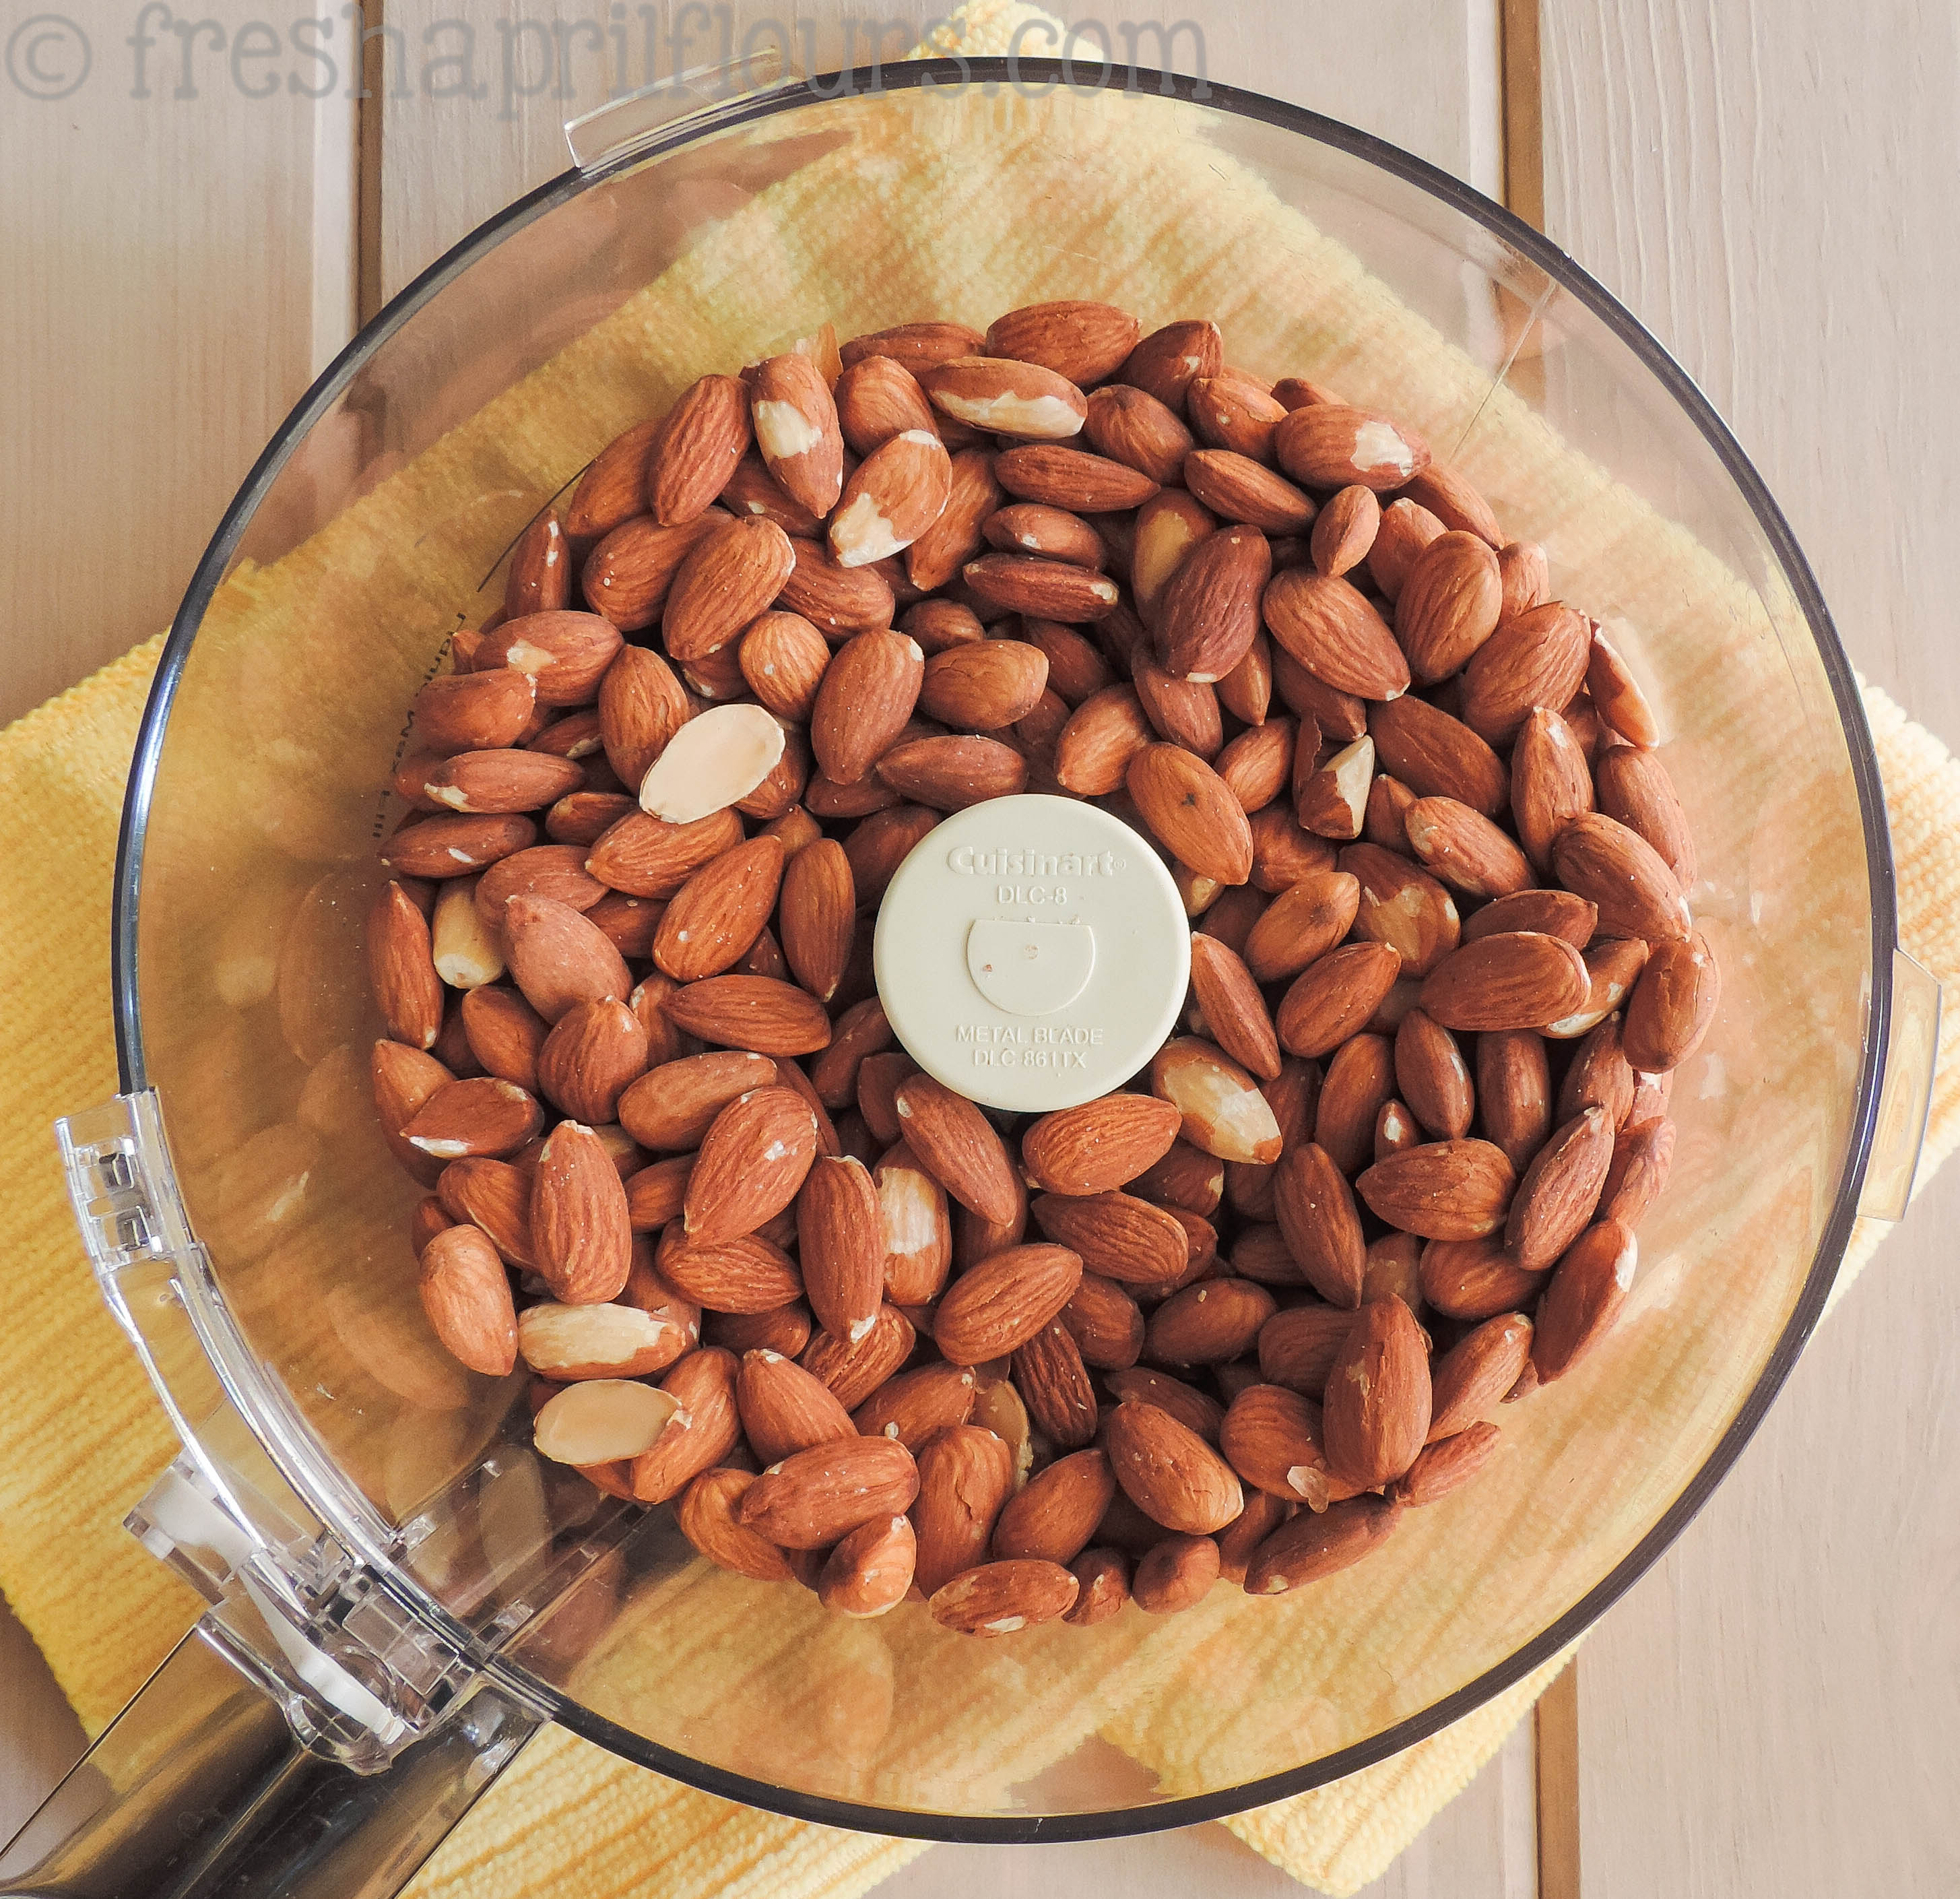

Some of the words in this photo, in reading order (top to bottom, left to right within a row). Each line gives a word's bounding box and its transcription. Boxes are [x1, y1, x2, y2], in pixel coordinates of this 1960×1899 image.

[997, 884, 1068, 905] DLC-8
[955, 1025, 1026, 1044] METAL
[1033, 1026, 1104, 1045] BLADE
[972, 1048, 1087, 1068] DLC-861TX
